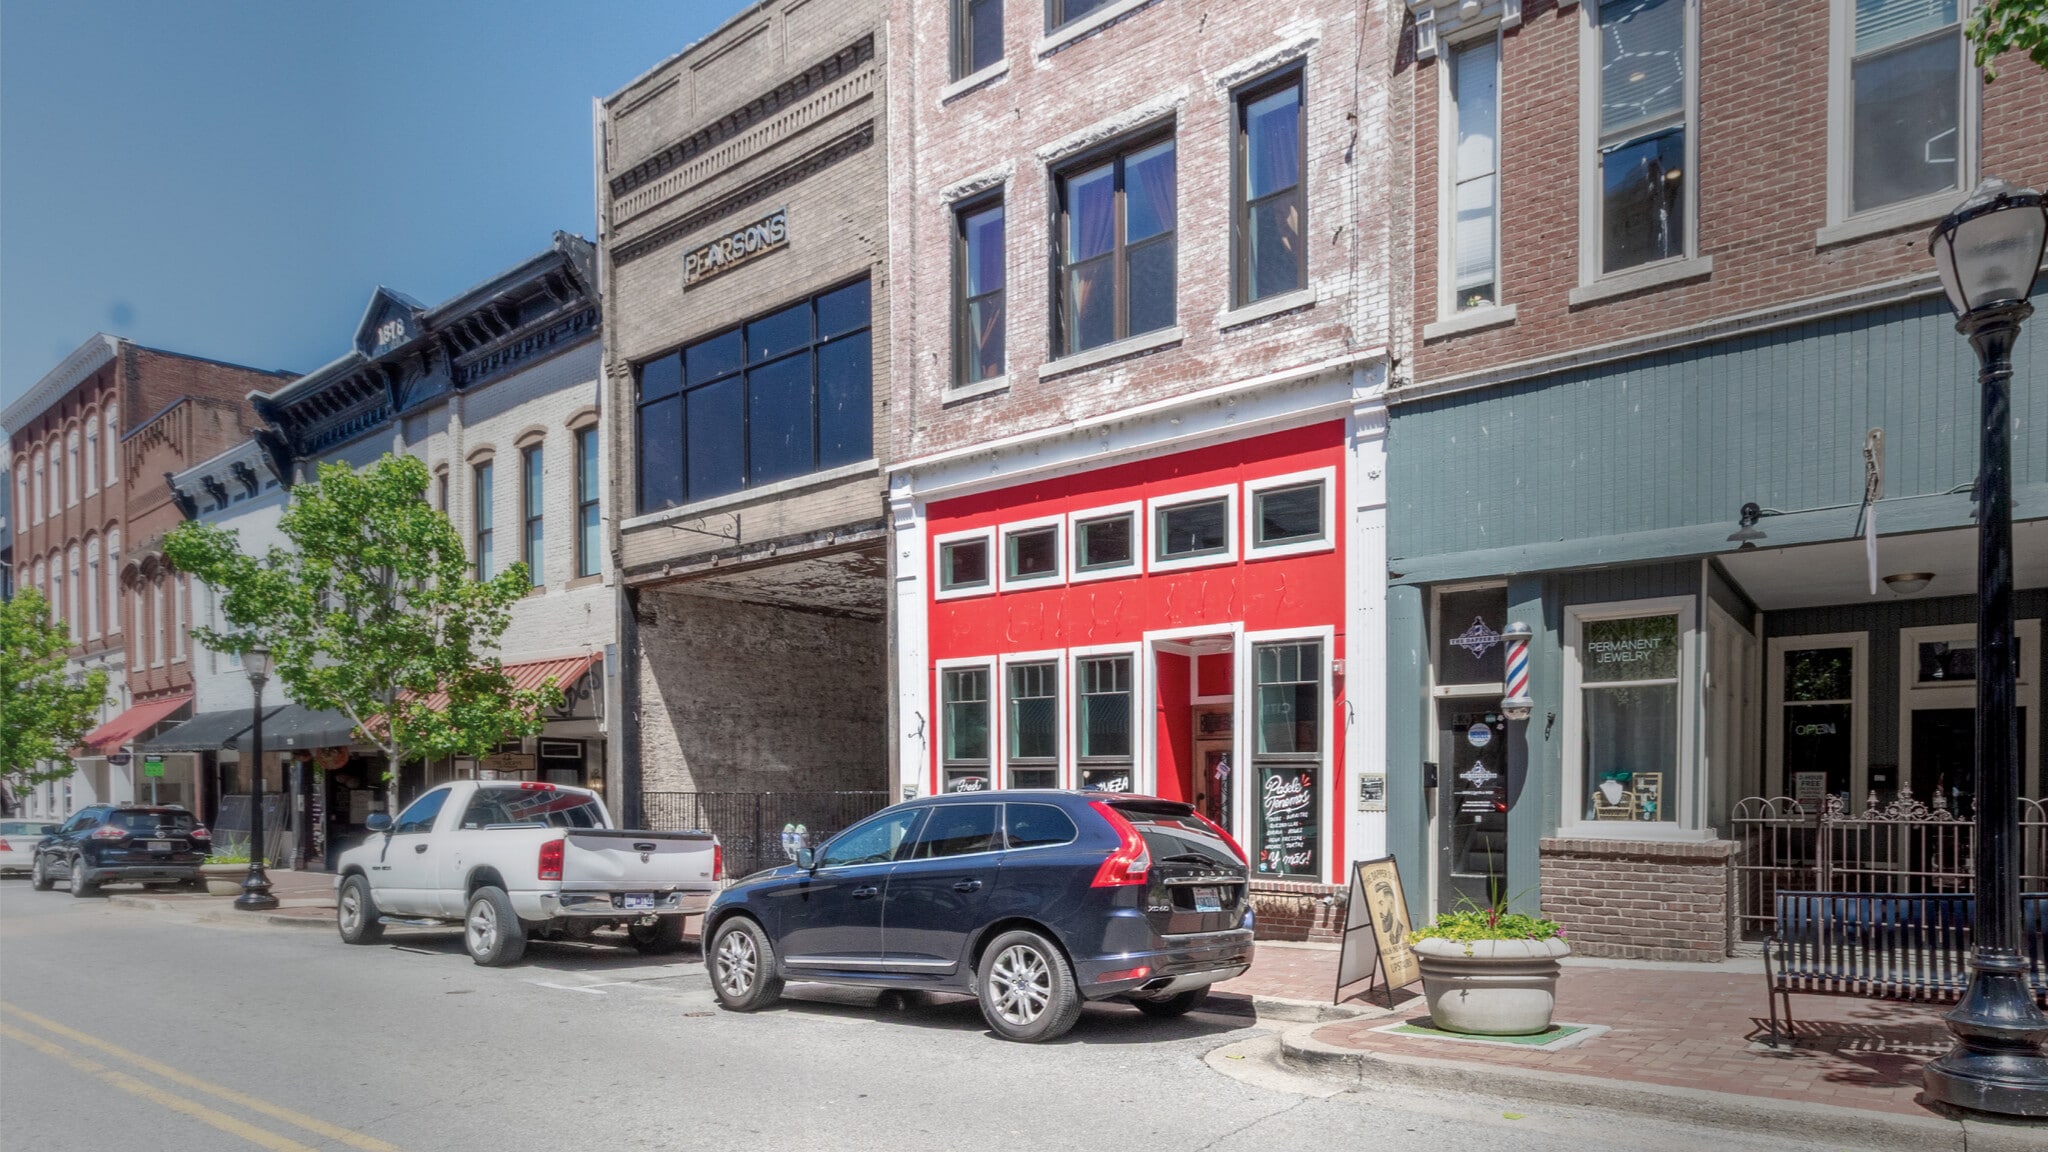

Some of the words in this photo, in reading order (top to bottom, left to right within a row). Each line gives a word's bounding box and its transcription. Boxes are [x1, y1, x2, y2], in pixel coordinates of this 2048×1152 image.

[684, 214, 785, 283] PEARSONS
[1451, 637, 1464, 645] THE
[1465, 635, 1492, 643] DAPPER
[1588, 638, 1662, 652] PERMANENT
[1597, 650, 1651, 663] JEWELRY
[1795, 723, 1836, 735] OPEN
